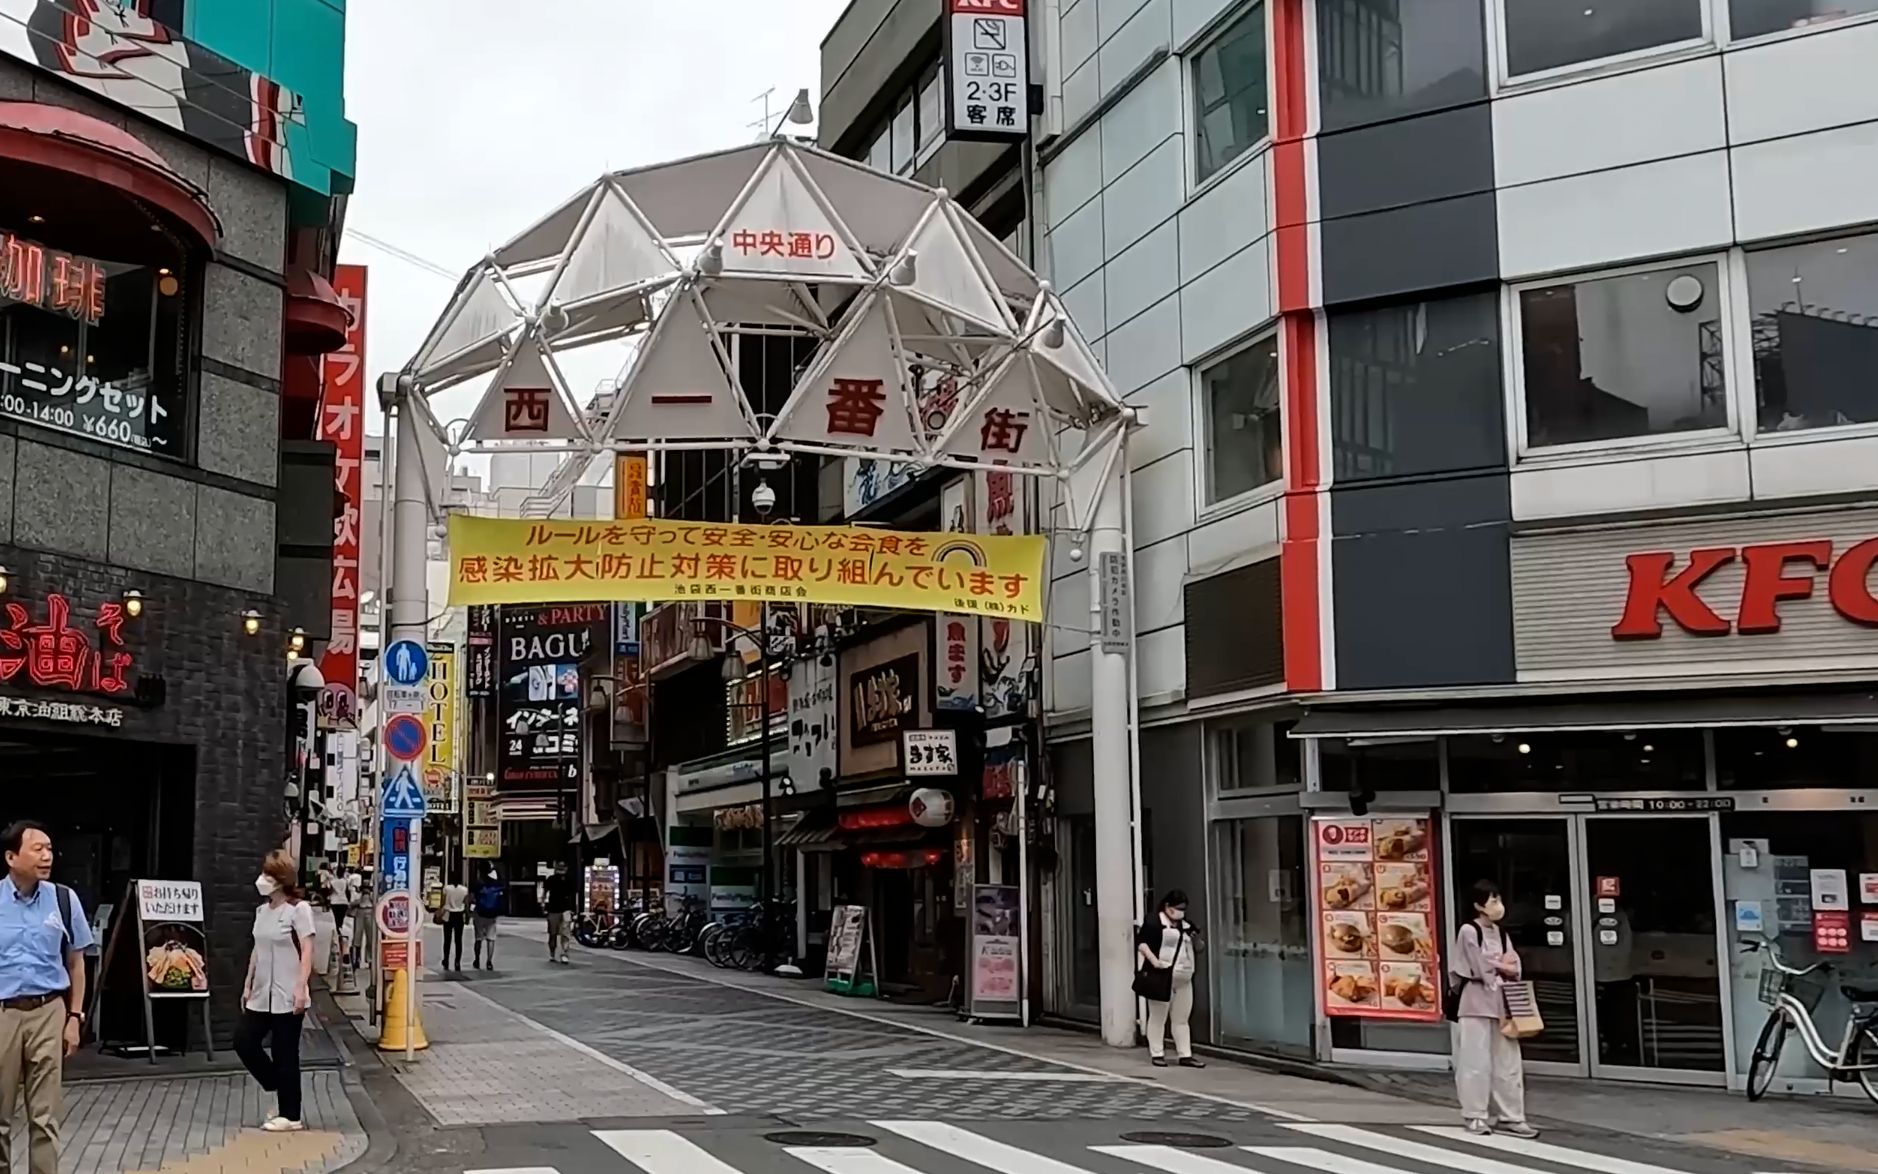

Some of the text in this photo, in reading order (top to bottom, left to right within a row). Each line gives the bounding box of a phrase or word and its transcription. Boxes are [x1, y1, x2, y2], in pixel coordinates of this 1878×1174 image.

[967, 105, 1016, 126] 客席
[733, 229, 835, 260] 中央通り
[503, 378, 1030, 453] 西一番街
[526, 525, 929, 556] ルールを守って安全・安心な会食を
[460, 552, 1028, 598] 感染拡大防止対策に取り組んでいます
[675, 584, 807, 597] 池袋西一番街商店会
[1611, 537, 1878, 642] KFC
[550, 603, 609, 624] PARTY
[0, 593, 88, 690] 油
[510, 628, 590, 661] BAGU
[429, 661, 448, 763] HOTEL
